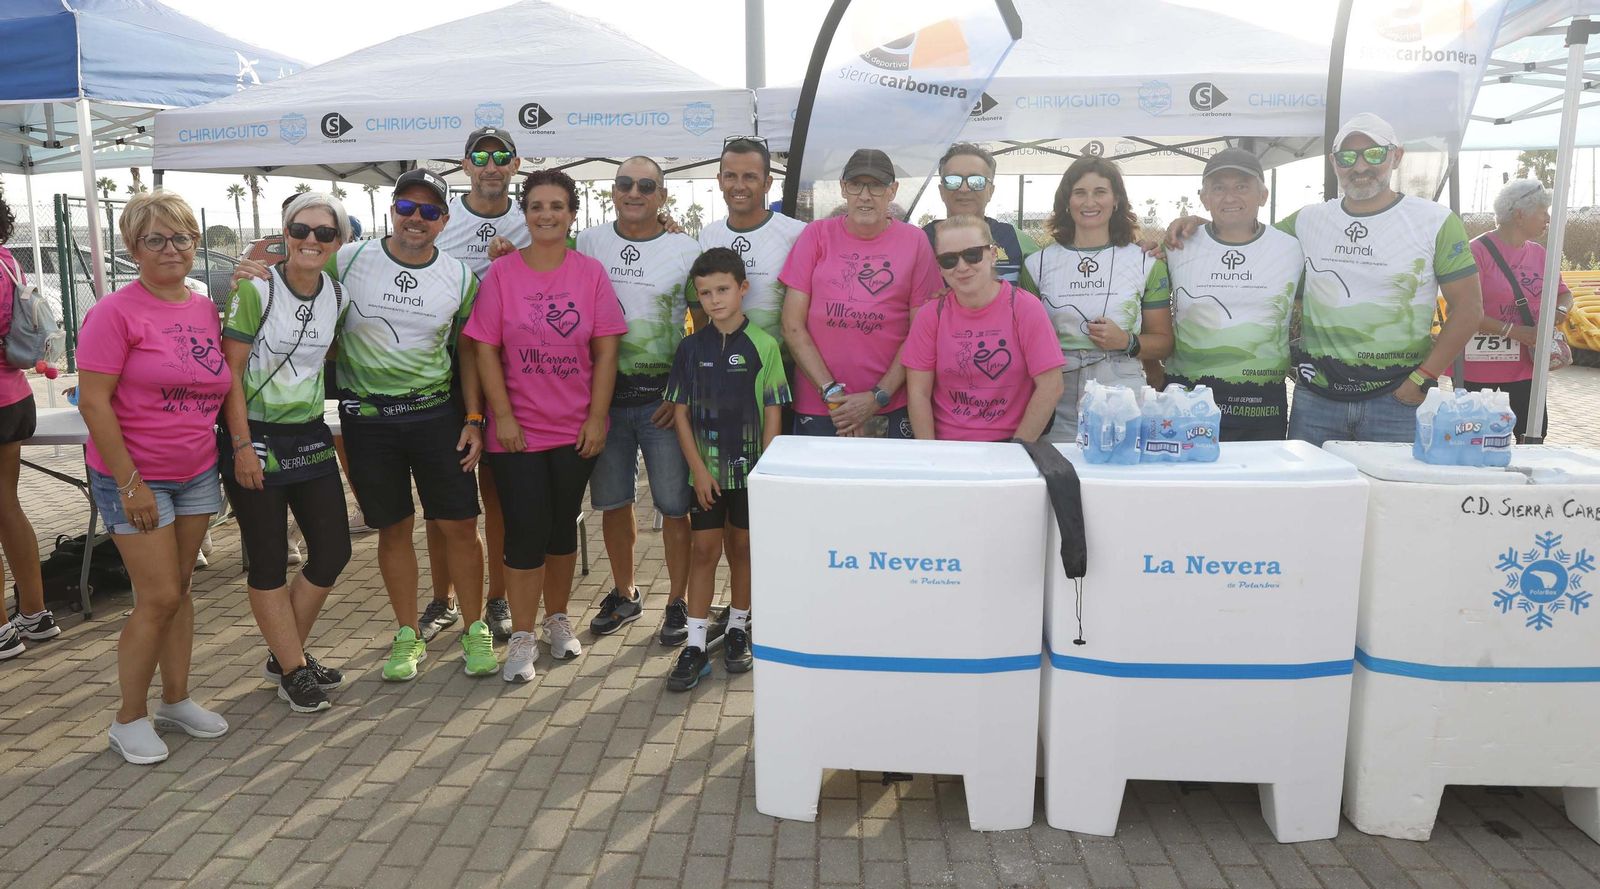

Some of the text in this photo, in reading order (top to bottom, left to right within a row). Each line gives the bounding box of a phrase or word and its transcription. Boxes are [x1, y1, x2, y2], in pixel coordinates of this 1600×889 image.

[1362, 45, 1477, 65] carbonera
[838, 65, 967, 99] sierracarbonera
[1016, 93, 1121, 110] CHIRINGUITO
[1248, 93, 1327, 107] CHIRINGU
[366, 116, 461, 131] CHIRINGUITO
[567, 111, 670, 127] CHIRINGUITO
[178, 124, 269, 143] CHIRINGUITO
[1334, 245, 1373, 256] mundi
[610, 265, 644, 278] mundi
[1210, 270, 1252, 281] mundi
[1070, 277, 1105, 289] mundi
[383, 293, 424, 307] mundi
[1474, 336, 1512, 350] 751
[828, 550, 962, 572] La Nevera
[1143, 554, 1281, 575] La Nevera
